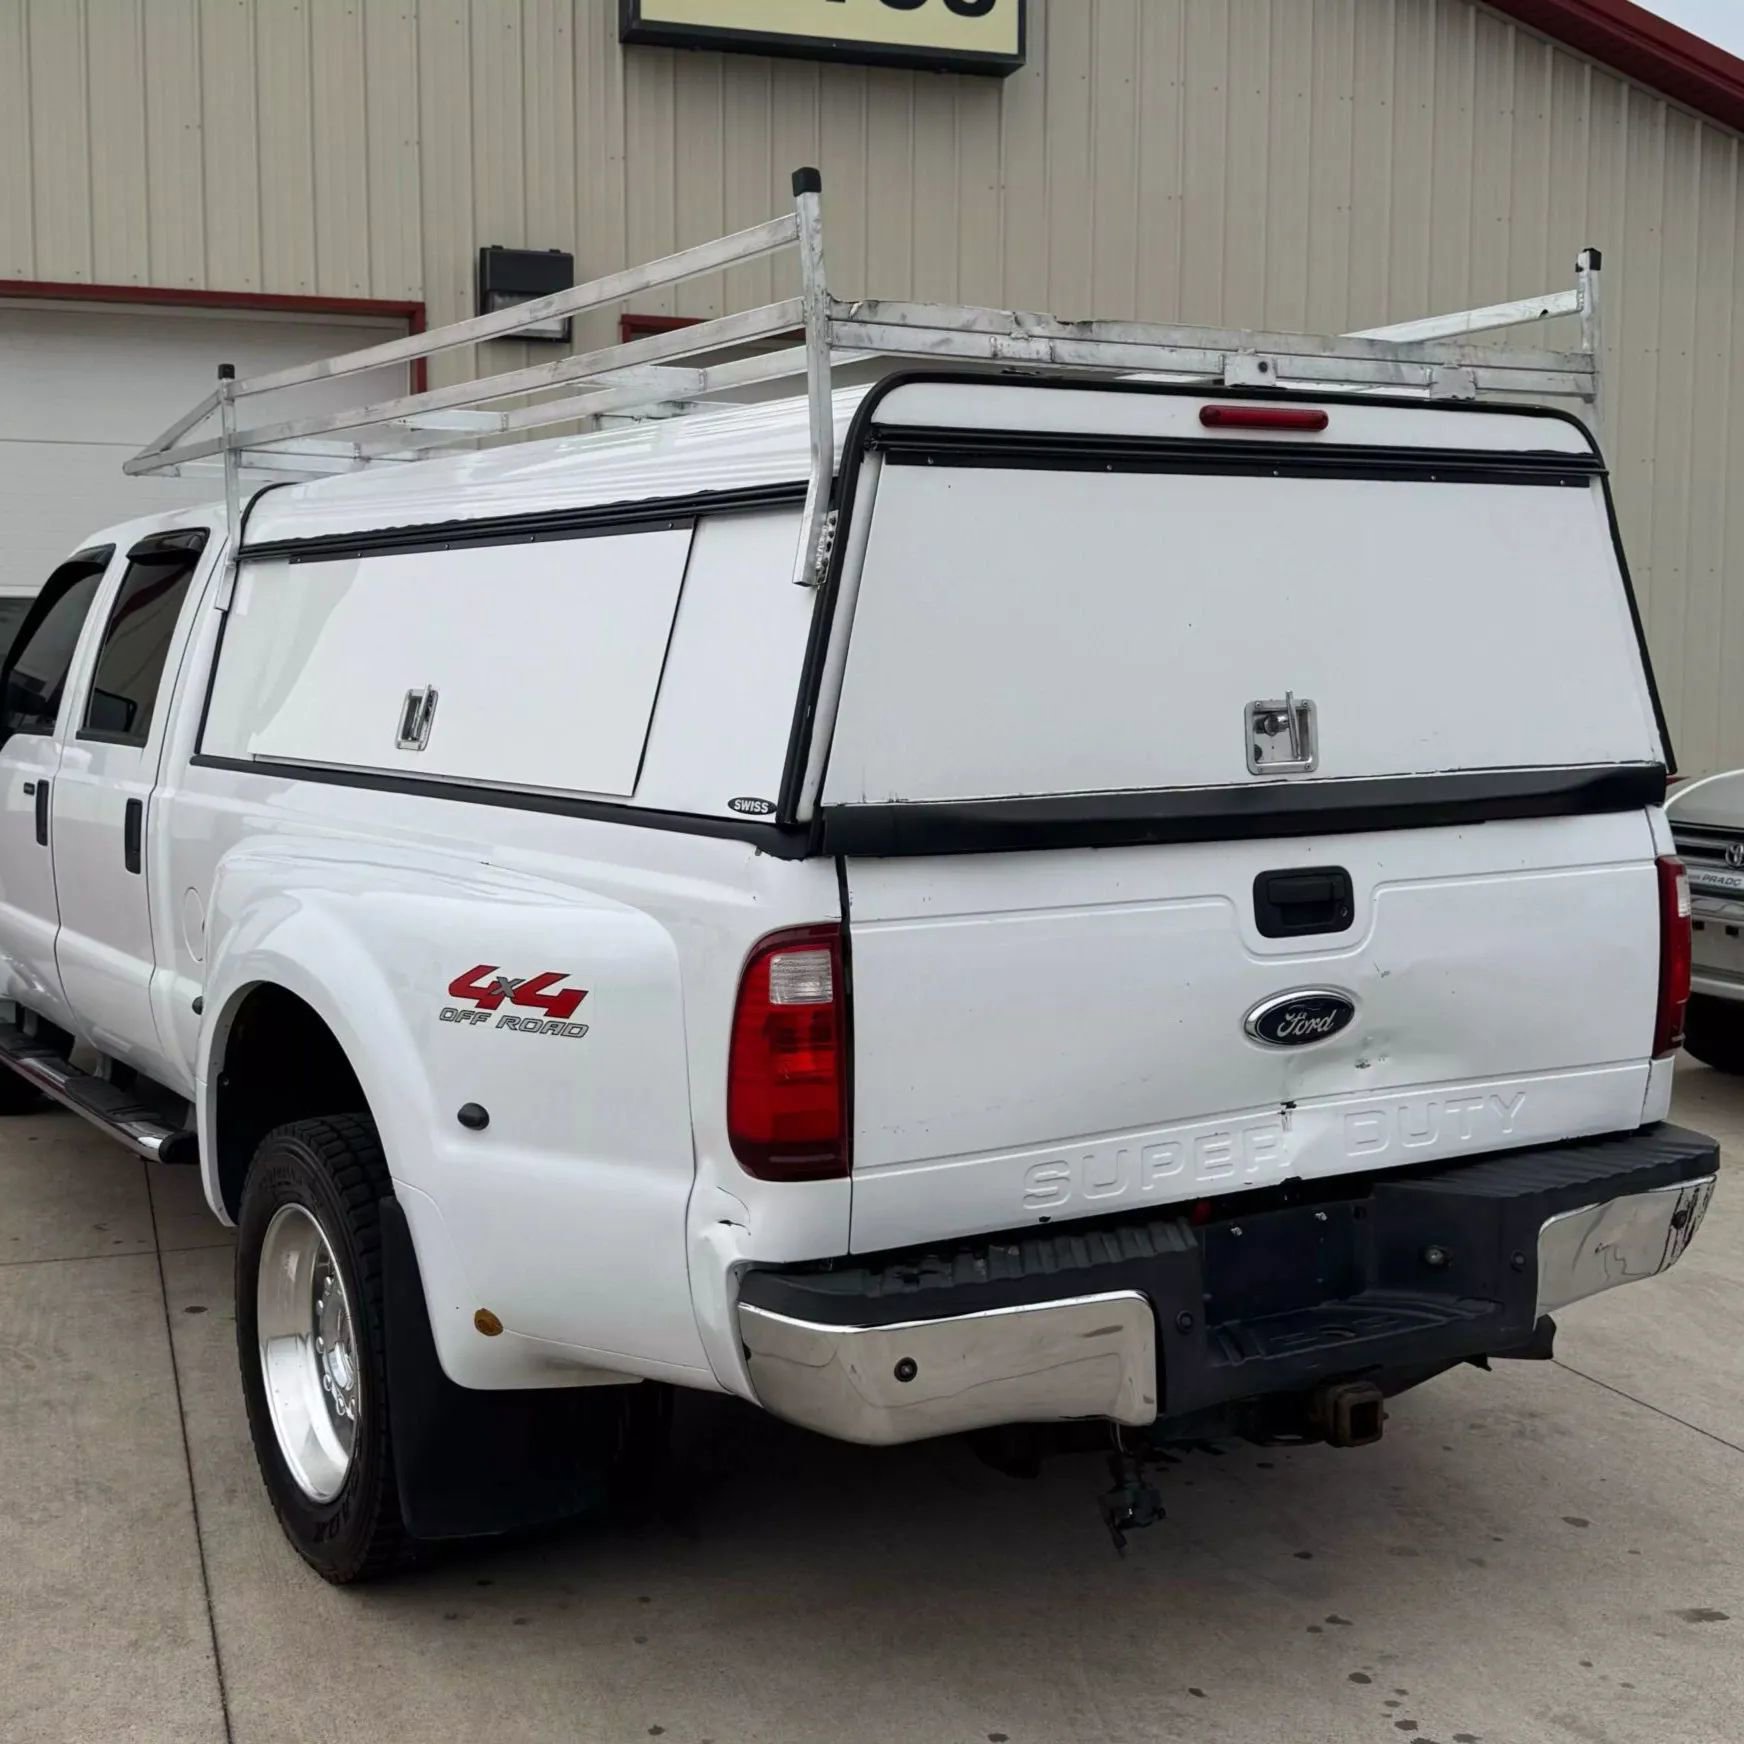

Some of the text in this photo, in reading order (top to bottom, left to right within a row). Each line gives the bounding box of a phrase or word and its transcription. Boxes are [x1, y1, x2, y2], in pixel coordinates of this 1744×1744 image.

[733, 799, 769, 814] SWISS
[439, 1007, 590, 1039] OFF ROAD
[1276, 1009, 1337, 1038] Ford
[1023, 1091, 1526, 1210] SUPER DUTY
